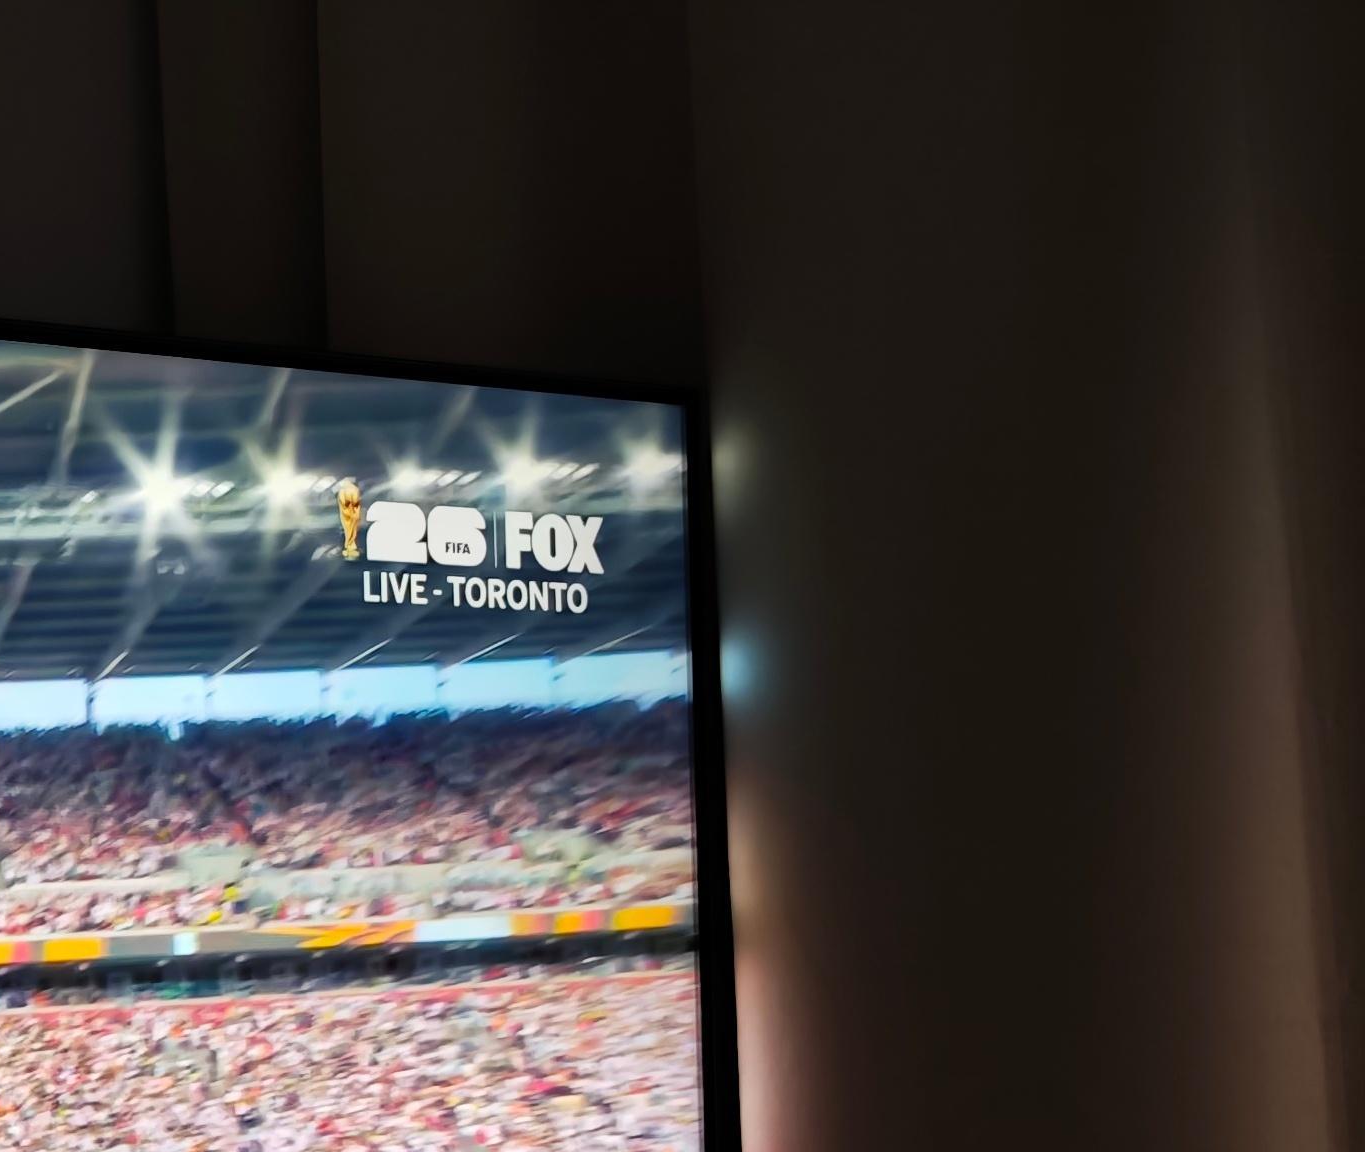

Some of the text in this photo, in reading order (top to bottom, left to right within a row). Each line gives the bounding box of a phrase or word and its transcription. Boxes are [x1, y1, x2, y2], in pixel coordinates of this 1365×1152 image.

[366, 501, 486, 567] 26
[445, 541, 471, 555] FIFA
[505, 511, 604, 574] FOX
[364, 571, 429, 605] LIVE
[446, 575, 588, 614] TORONTO
